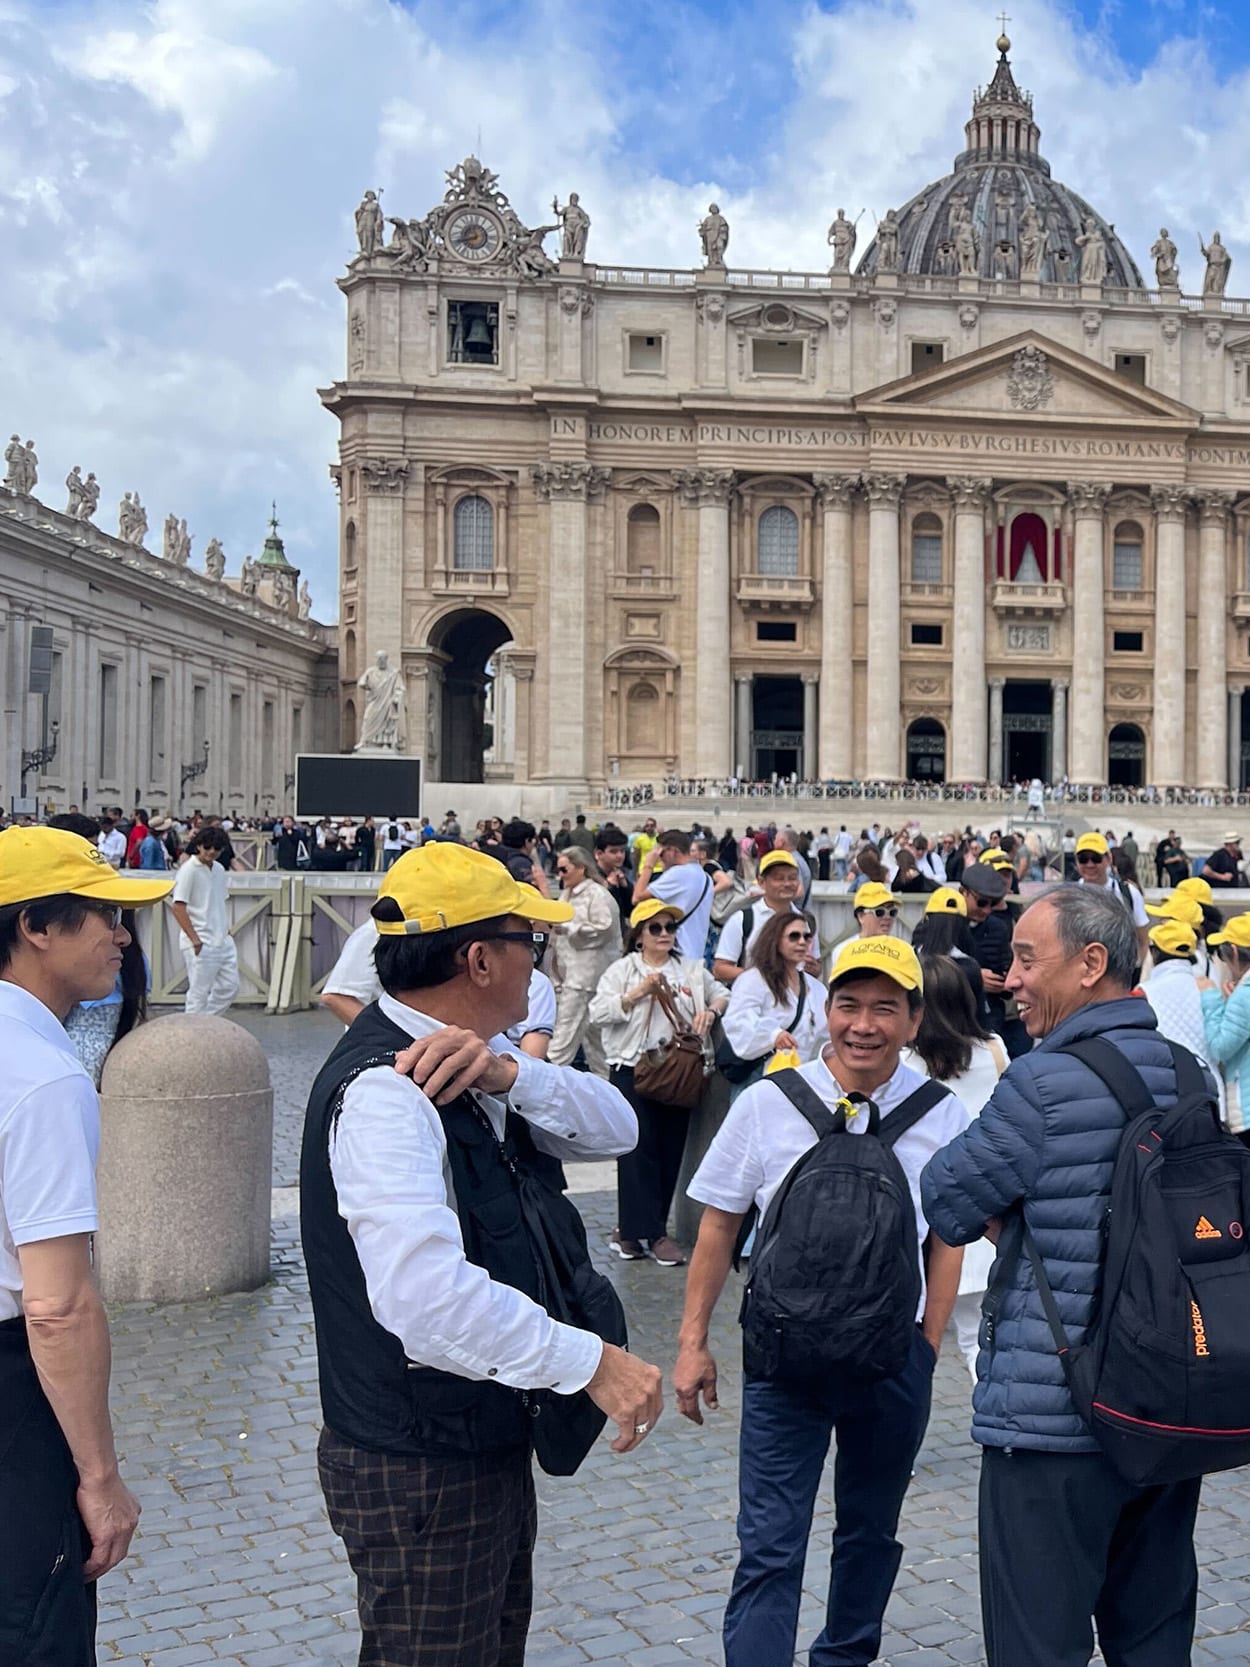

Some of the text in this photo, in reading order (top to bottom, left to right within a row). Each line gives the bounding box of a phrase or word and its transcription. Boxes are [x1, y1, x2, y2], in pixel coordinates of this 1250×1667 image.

[553, 418, 577, 434] IN
[589, 424, 695, 443] HONOREM
[700, 426, 802, 445] PRINCIPIS
[872, 431, 939, 447] PAVLVS
[960, 435, 1082, 455] BVRGHESIVS
[1086, 440, 1185, 459] ROMANVS
[1191, 1300, 1210, 1356] predator
